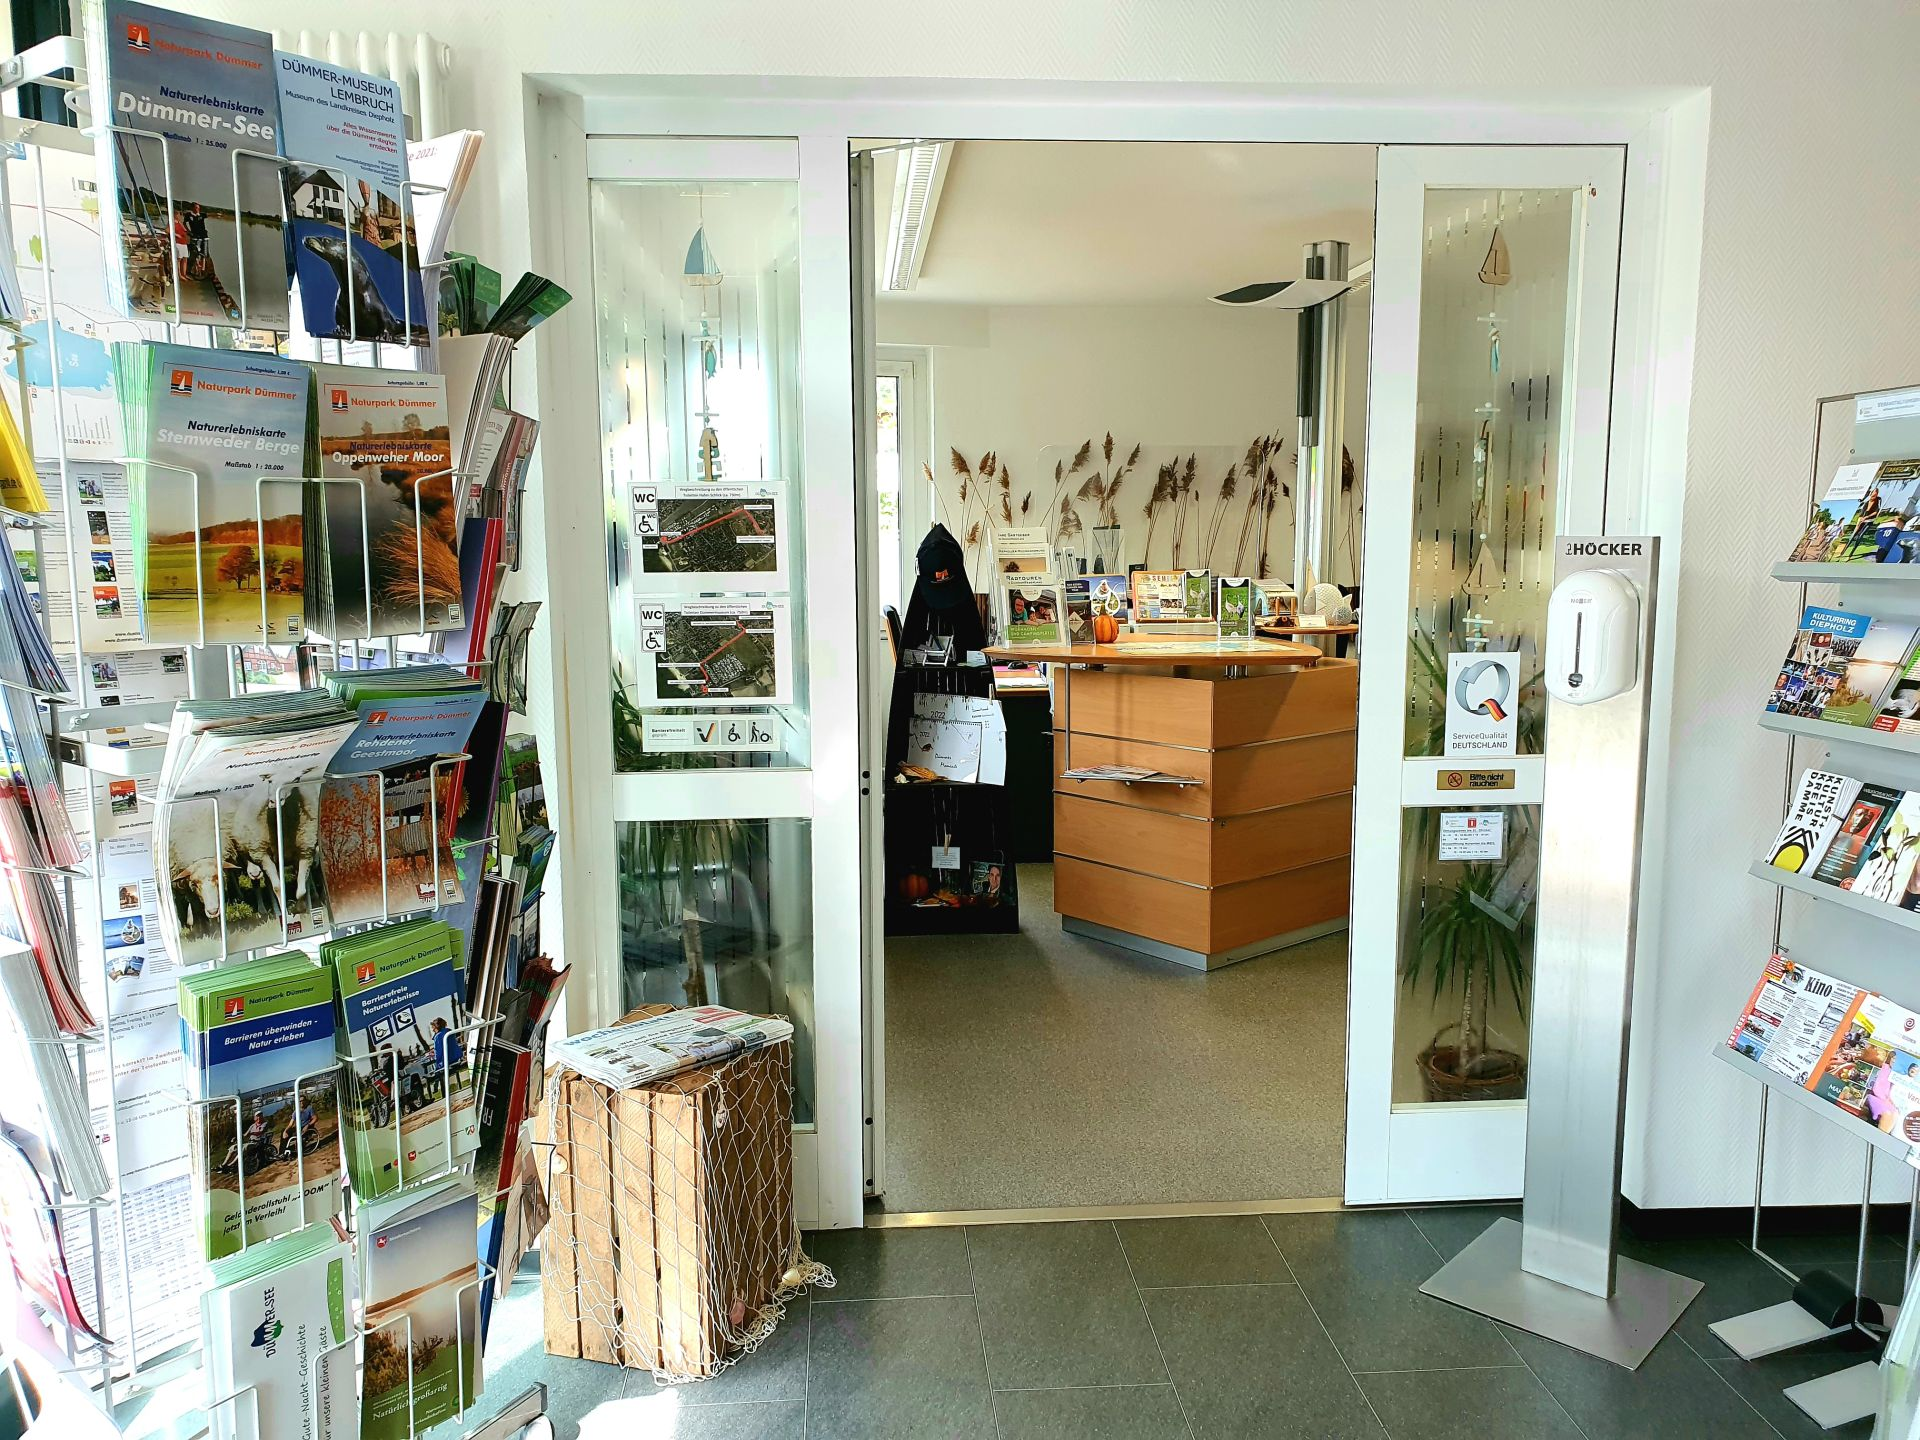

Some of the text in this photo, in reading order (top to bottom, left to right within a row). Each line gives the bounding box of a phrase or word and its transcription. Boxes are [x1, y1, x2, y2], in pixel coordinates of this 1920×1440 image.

[154, 39, 211, 60] Naturpark
[282, 58, 393, 98] DÜMMER-MUSEUM
[160, 86, 264, 116] Naturerlebniskarte
[285, 90, 395, 124] Museum des Landkreises Diepholz
[330, 87, 394, 113] LEMBRUCH
[118, 91, 274, 140] Dümmer-See
[326, 124, 340, 133] über
[341, 128, 350, 136] die
[343, 121, 357, 131] Alles
[197, 380, 297, 400] Naturpark Dümmer
[351, 398, 437, 409] Naturpark Dümmer
[187, 420, 287, 439] Naturerlebniskarte
[157, 428, 300, 456] Stemweder Berge
[350, 441, 432, 451] Naturerlebniskarte
[224, 461, 252, 469] Maßstab
[332, 451, 445, 464] Oppenweher Moor
[634, 493, 655, 503] WC
[1574, 542, 1642, 556] HÖCKER
[642, 610, 662, 620] WC
[1812, 612, 1857, 627] KULTURRING
[1809, 619, 1855, 634] DIEPHOLZ
[388, 711, 472, 723] Naturpark Dümmer
[930, 710, 946, 719] 2022
[355, 738, 417, 749] Rehdener
[373, 731, 457, 741] Naturerlebniskarte
[1452, 731, 1508, 740] ServiceQualität
[1452, 741, 1508, 749] DEUTSCHLAND
[243, 745, 298, 757] Naturpark
[350, 748, 417, 759] Geestmoor
[225, 752, 321, 770] Naturerlebniskarte
[1794, 771, 1819, 821] DAMME
[1806, 773, 1827, 816] KREIS
[1809, 775, 1835, 827] KULTUR
[1818, 777, 1843, 829] KUNST+
[379, 945, 446, 973] Naturpark Dümmer
[249, 987, 314, 1005] Naturpark Dümmer
[362, 985, 408, 1007] Barrierefreie
[1803, 976, 1833, 998] Kino
[363, 990, 420, 1016] Naturerlebnisse
[224, 1031, 263, 1046] Barrieren
[265, 1019, 312, 1036] überwinden
[248, 1032, 305, 1050] Natur erleben
[223, 1221, 241, 1238] jetzt
[254, 1206, 286, 1222] Verleih!
[263, 1286, 277, 1359] DÜMMER-SEE
[296, 1323, 311, 1440] Gute-Nacht-Geschichte
[320, 1355, 329, 1394] kleinen
[412, 1383, 448, 1406] großartig
[322, 1395, 331, 1427] unsere
